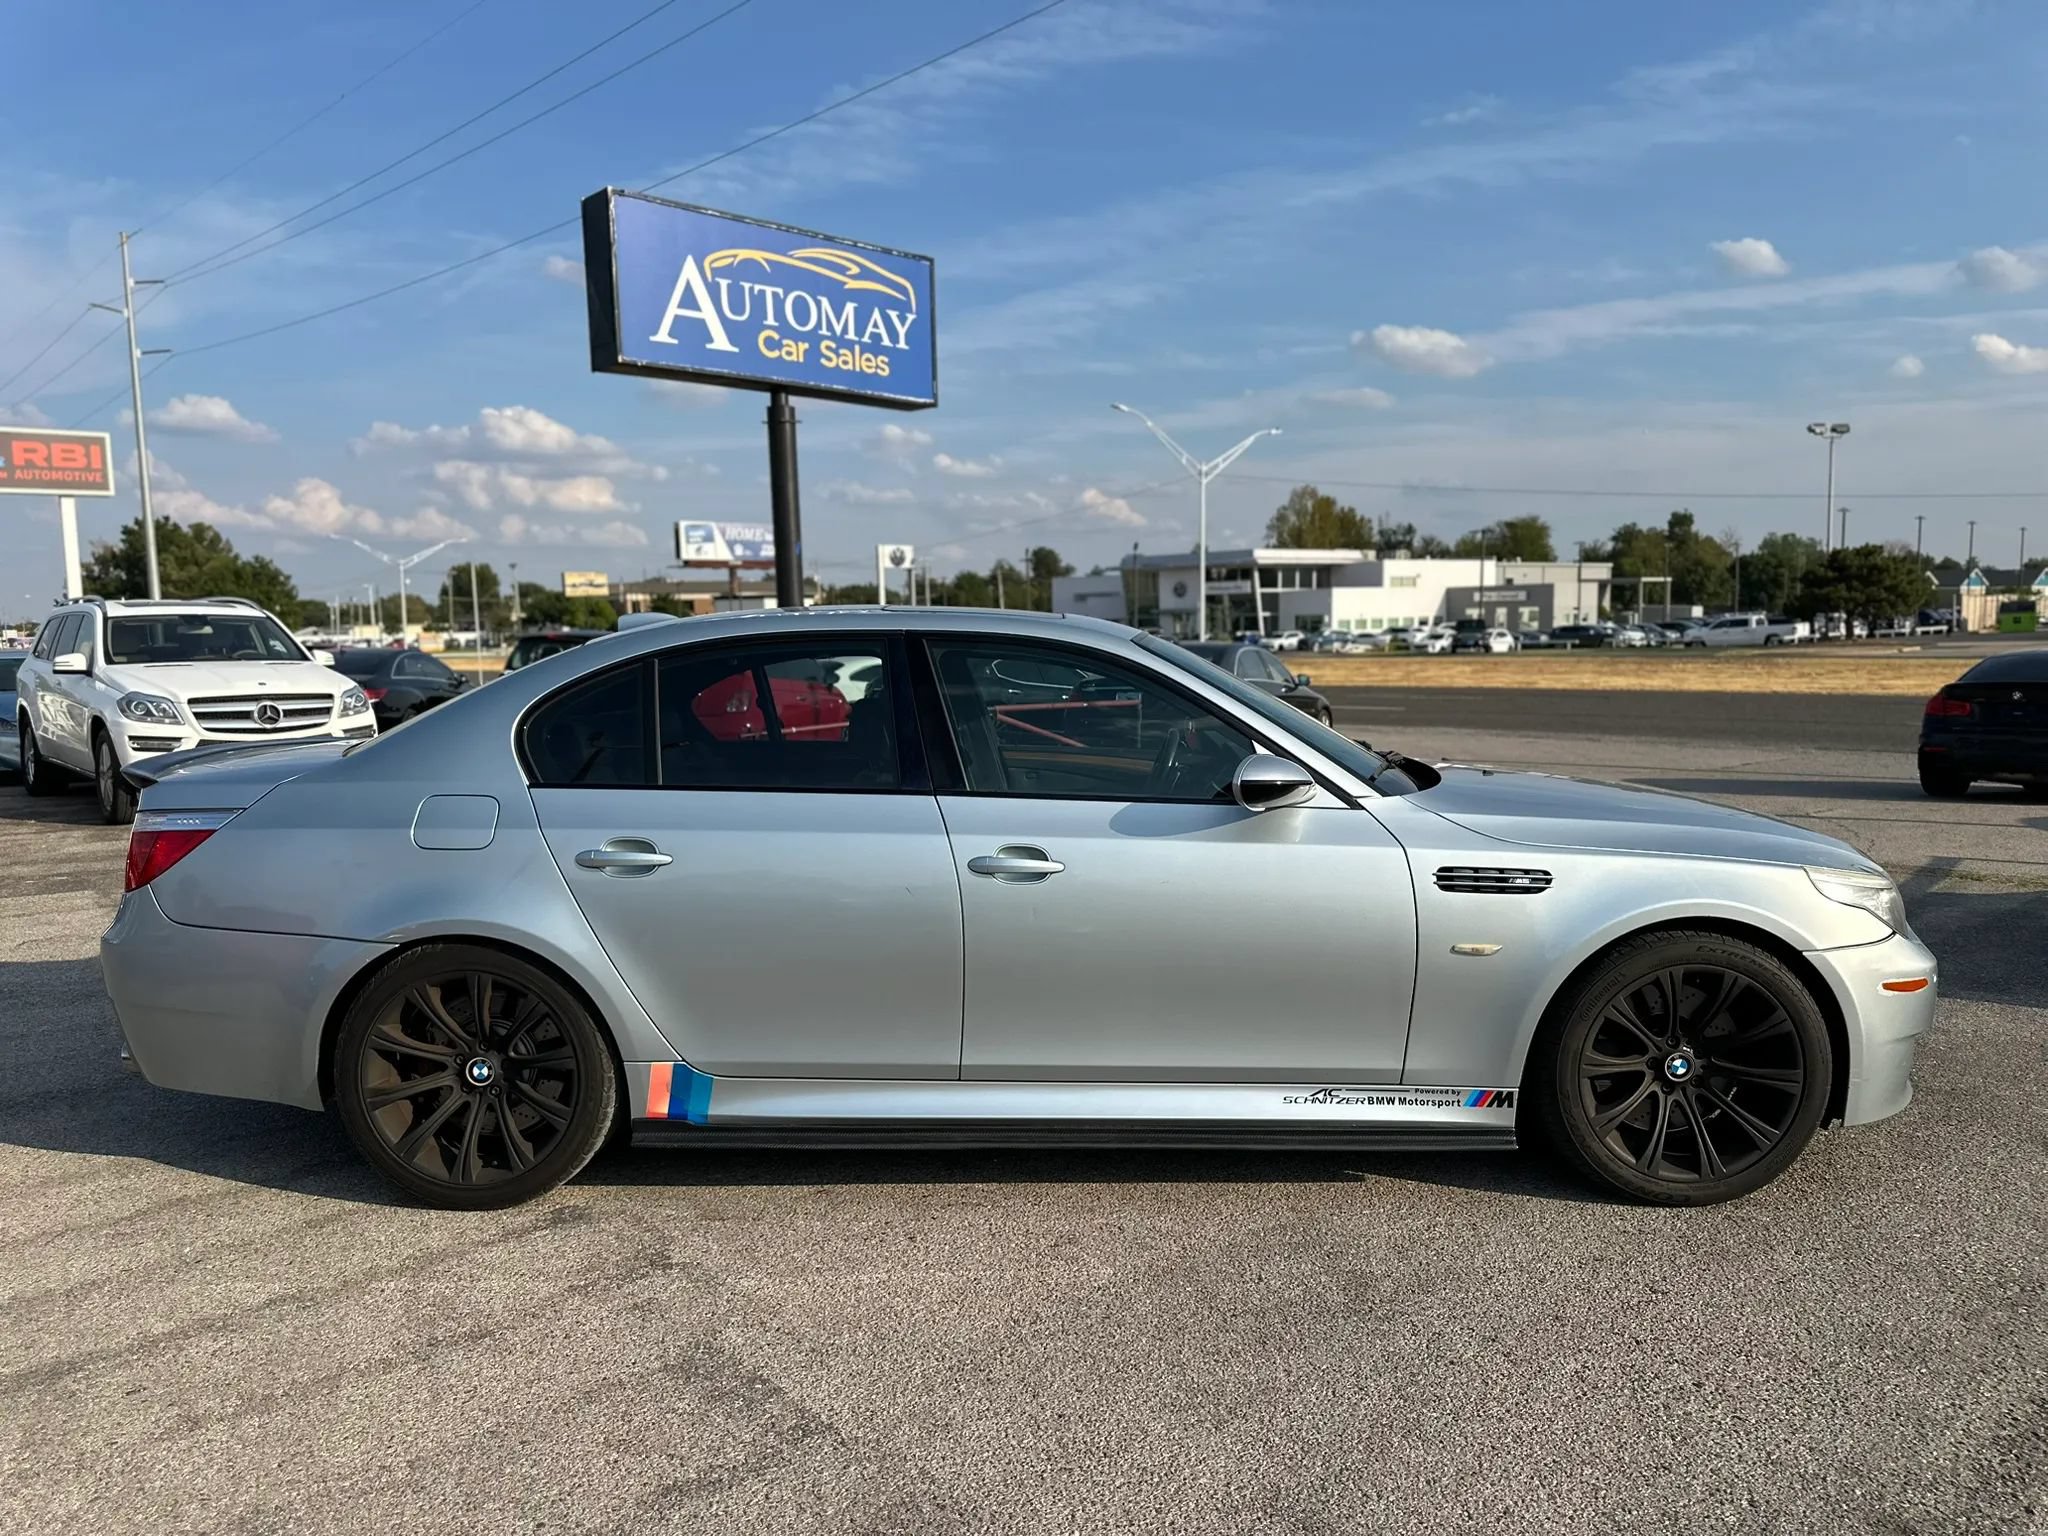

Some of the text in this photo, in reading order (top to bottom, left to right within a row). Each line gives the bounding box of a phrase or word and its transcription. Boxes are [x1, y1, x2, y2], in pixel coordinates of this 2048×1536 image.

[649, 254, 917, 353] AUTOMAY
[757, 329, 890, 377] Car Sales
[11, 440, 102, 469] RBI
[15, 469, 103, 482] AUTOMOTIVE
[1309, 1088, 1342, 1097] AC
[1282, 1096, 1366, 1105] SCHNITZER
[1367, 1096, 1461, 1109] BMW Motorsport
